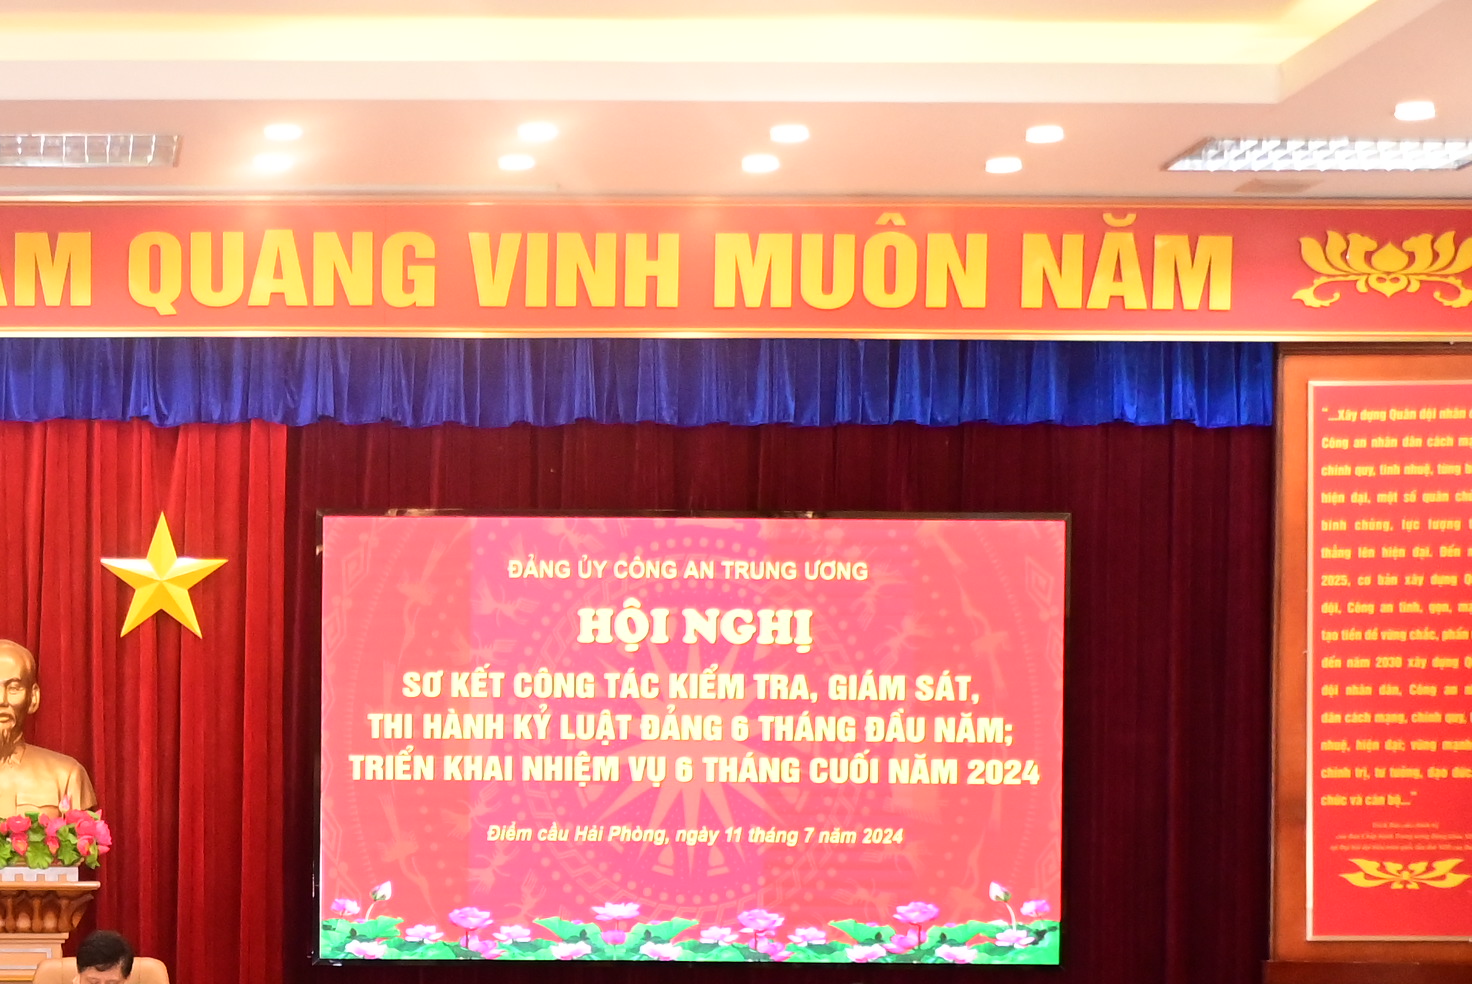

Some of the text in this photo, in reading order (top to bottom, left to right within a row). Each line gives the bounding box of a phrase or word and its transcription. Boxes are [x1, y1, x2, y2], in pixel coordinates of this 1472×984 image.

[127, 231, 435, 317] QUANG
[467, 231, 680, 310] VINH
[714, 213, 987, 310] MUÔN
[1021, 211, 1232, 312] NĂM
[508, 553, 869, 582] ĐẢNG ỦY CÔNG AN TRUNG ƯƠNG
[577, 597, 814, 654] HỘI NGHỊ
[402, 663, 981, 705] SƠ KẾT CÔNG TÁC KIỂM TRA, GIÁM SÁT,
[368, 703, 1014, 746] THI HÀNH KỶ LUẬT ĐẢNG 6 THÁNG ĐẦU NĂM;
[349, 745, 1041, 788] TRIỂN KHAI NHIỆM VỤ 6 THÁNG CUỐI NĂM 2024
[487, 823, 904, 847] Điểm cầu Hải Phòng, ngày 11 tháng 7 năm 2024
